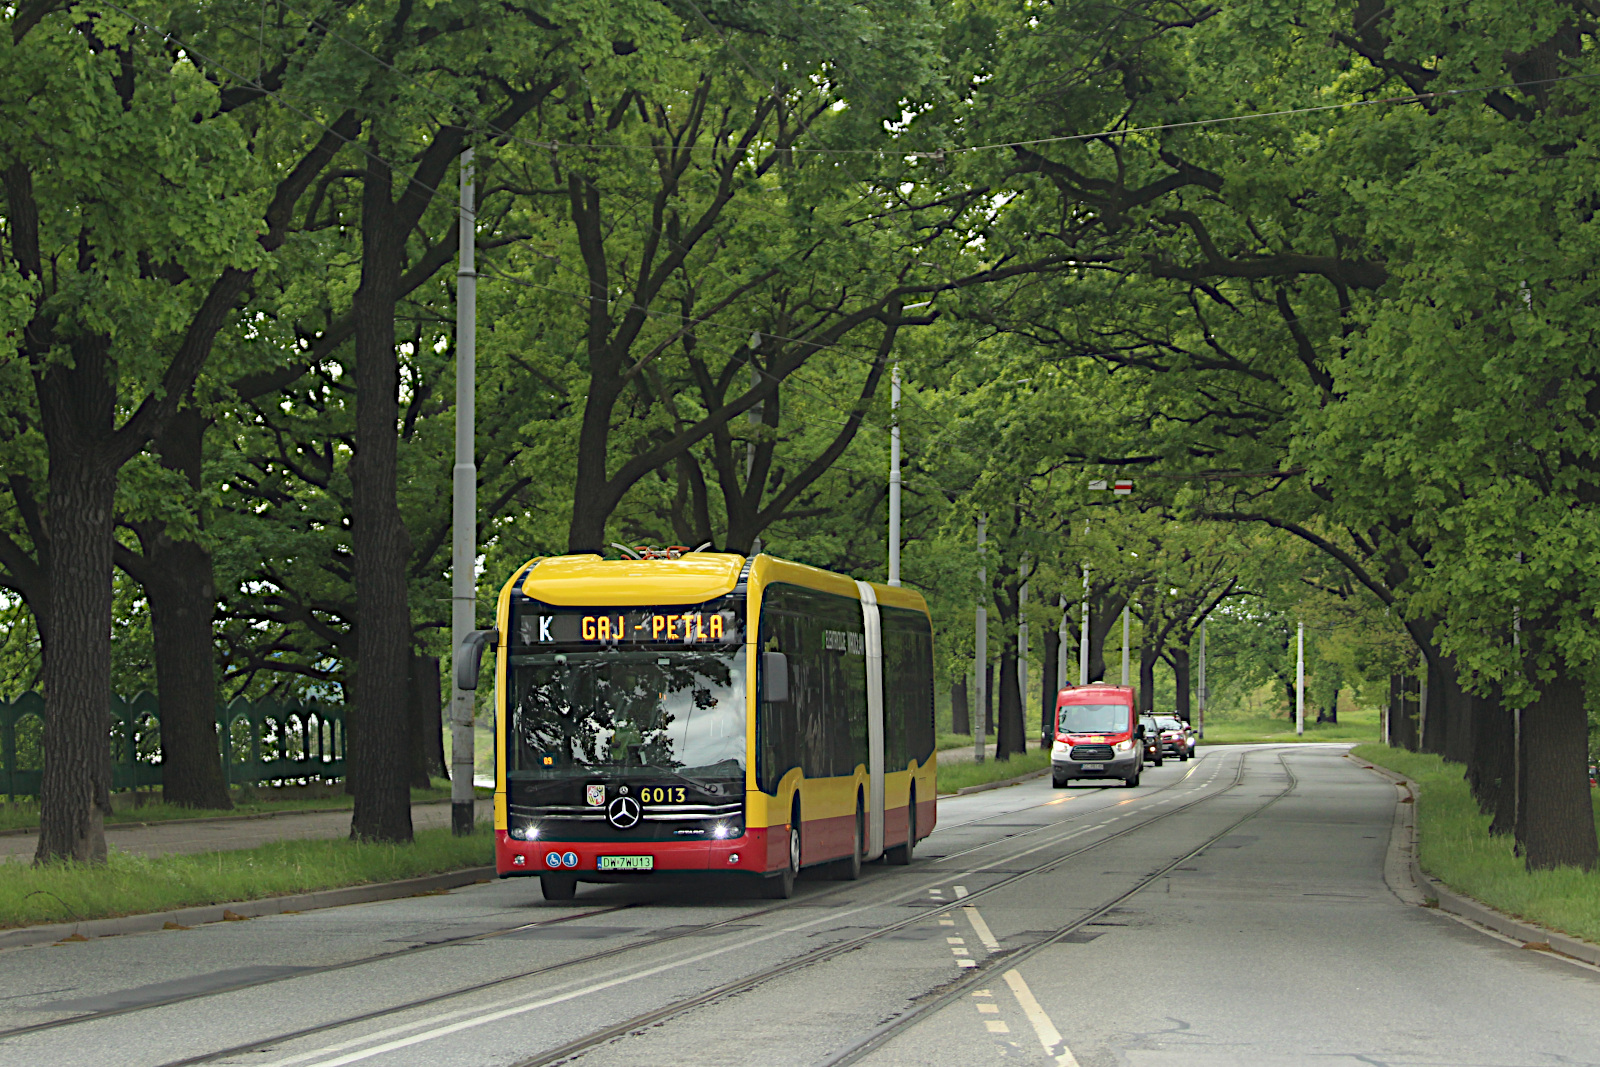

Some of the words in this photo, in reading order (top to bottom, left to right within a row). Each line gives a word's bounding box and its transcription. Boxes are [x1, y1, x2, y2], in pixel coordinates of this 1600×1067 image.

[539, 616, 553, 641] K
[582, 616, 624, 640] GAJ
[641, 788, 686, 802] 6013
